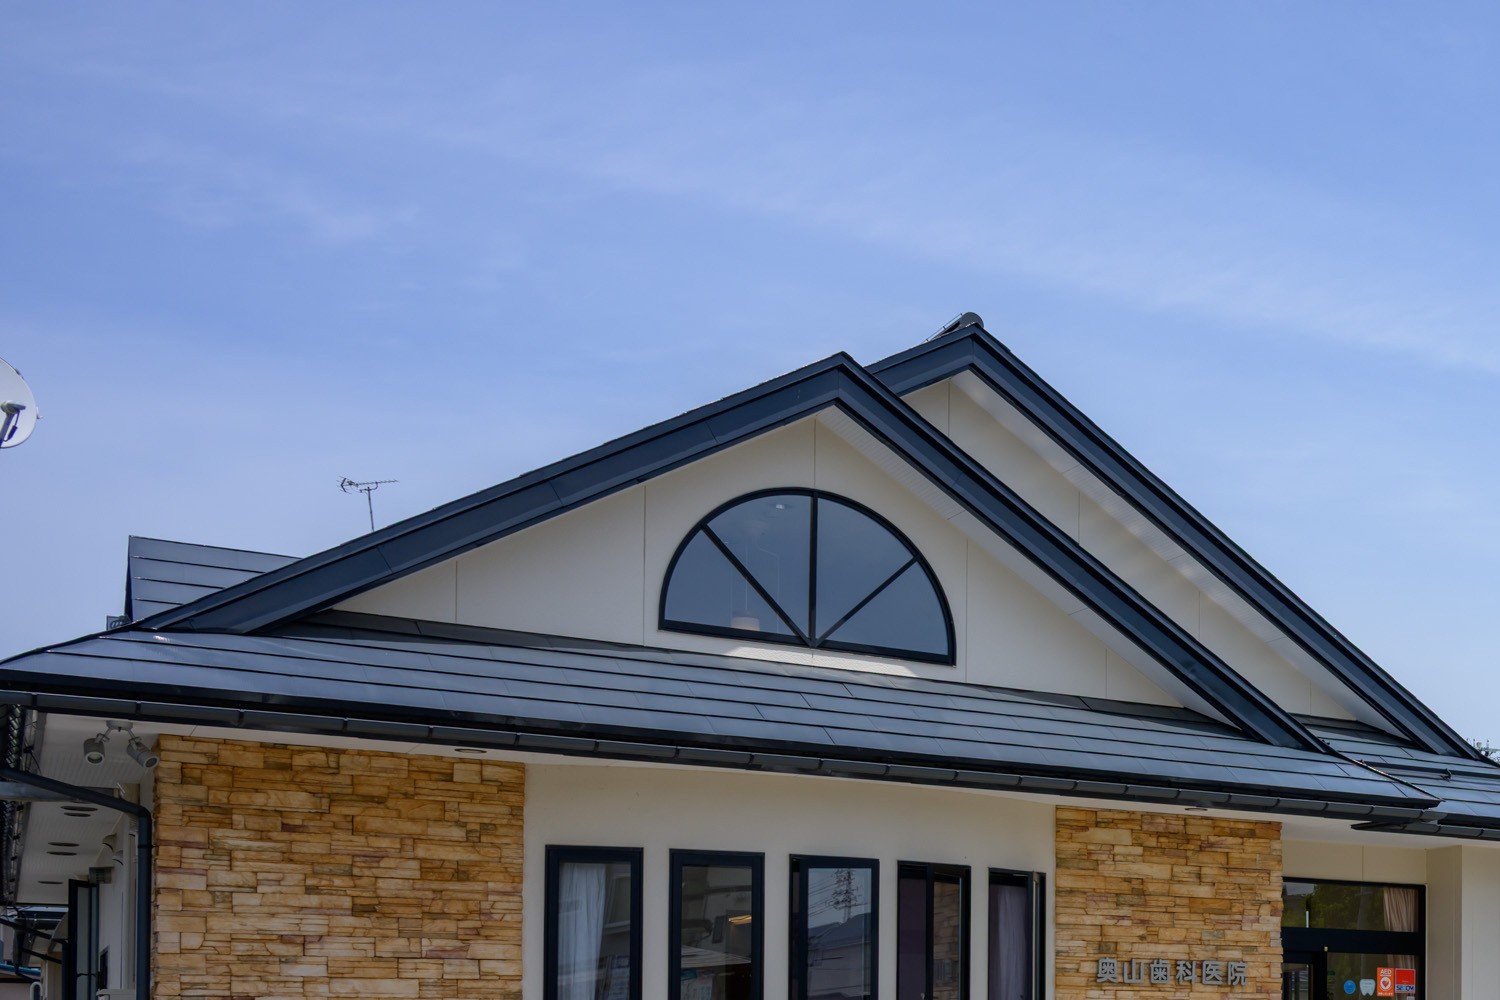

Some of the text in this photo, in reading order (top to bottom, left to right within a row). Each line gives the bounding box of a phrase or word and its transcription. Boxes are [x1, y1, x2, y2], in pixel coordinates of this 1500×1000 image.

[1097, 957, 1248, 986] 奥山歯科医院
